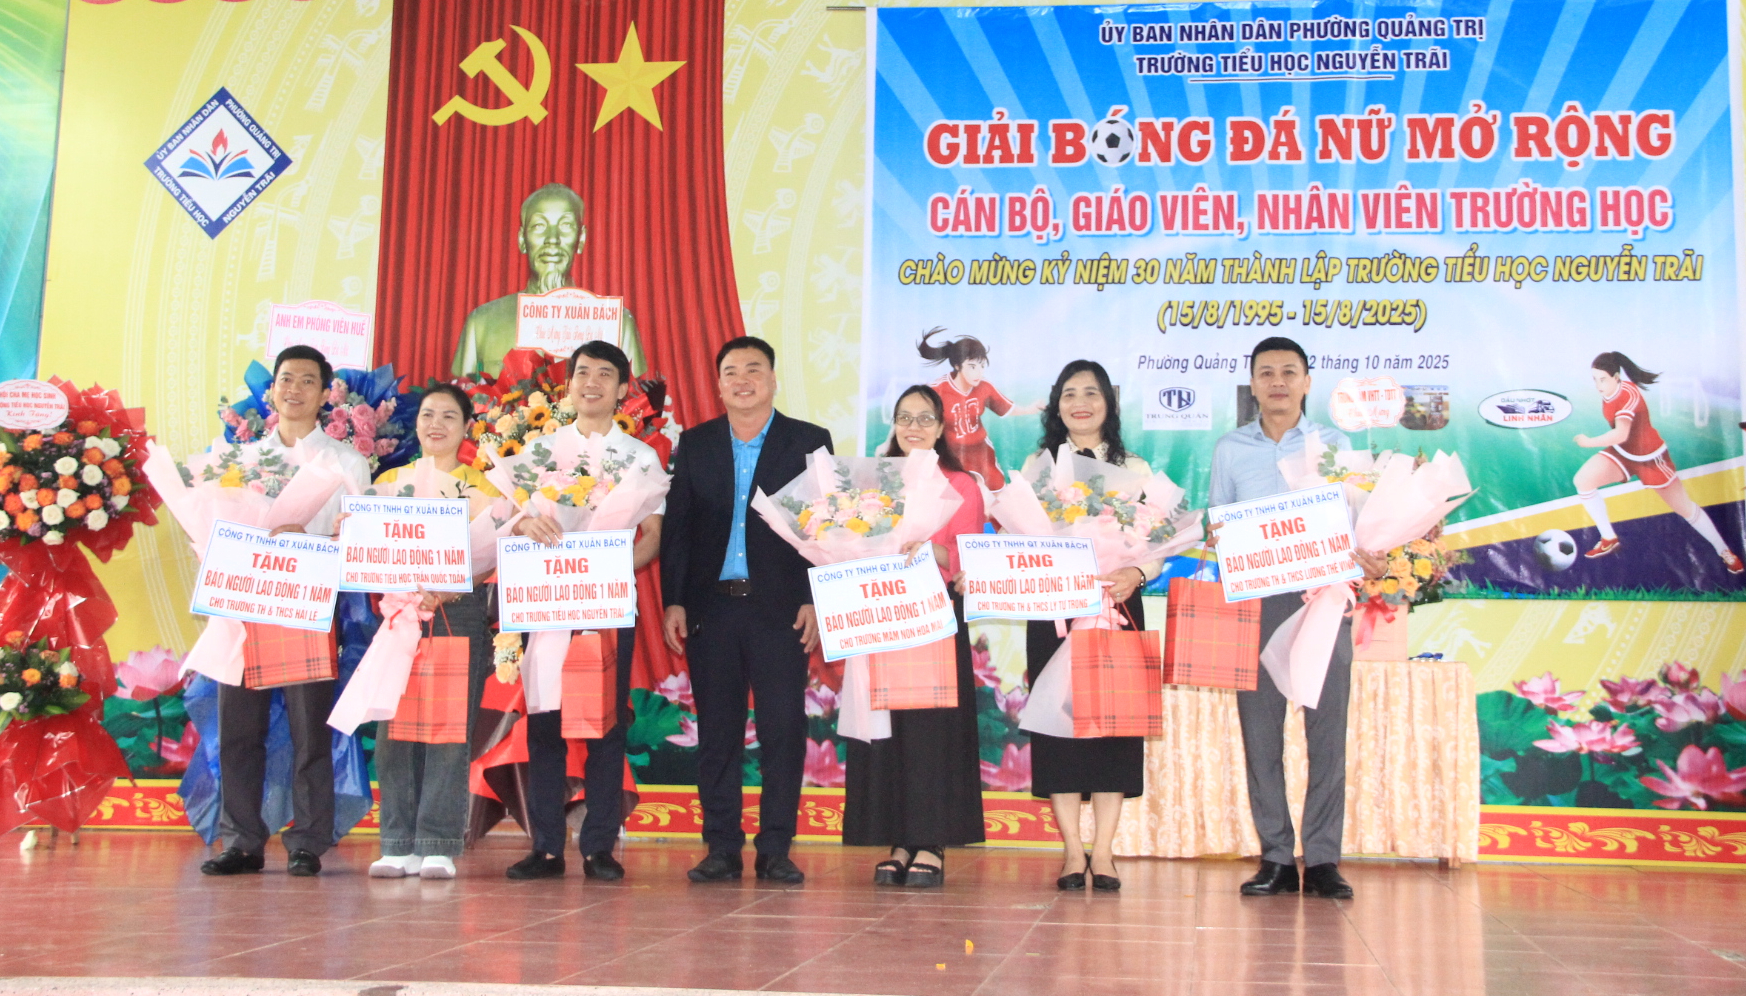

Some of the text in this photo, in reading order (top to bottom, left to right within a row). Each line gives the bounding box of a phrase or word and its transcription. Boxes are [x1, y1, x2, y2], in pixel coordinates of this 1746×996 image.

[1101, 14, 1484, 43] ỦY BAN NHÂN DÂN PHƯỜNG QUẢNG TRỊ
[1136, 46, 1448, 76] TRƯỜNG TIỂU HỌC NGUYỄN TRÃI
[157, 99, 219, 160] ỦY BAN NHÂN DÂN
[225, 99, 281, 159] PHƯỜNG QUẢNG TRỊ
[927, 111, 1034, 164] GIẢI
[1229, 109, 1302, 162] ĐÁ
[1319, 108, 1392, 161] NỮ
[1406, 104, 1496, 159] MỞ
[1513, 104, 1672, 168] RỘNG
[154, 166, 209, 226] TRƯỜNG TIỂU HỌC
[222, 172, 276, 223] NGUYỄN TRÃI
[930, 182, 1669, 240] CÁN BỘ, GIÁO VIÊN, NHÂN VIÊN TRƯỜNG HỌC
[899, 243, 1704, 291] CHÀO MỪNG KỶ NIỆM 30 NĂM THÀNH LẬP TRƯỜNG TIỂU HỌC NGUYỄN TRÃI
[275, 313, 291, 328] ANH
[293, 316, 304, 329] EM
[333, 317, 349, 334] VIÊN
[523, 302, 617, 320] CÔNG TY XUÂN BÁCH
[1157, 300, 1284, 333] (15/8/1995
[1302, 300, 1427, 333] 15/8/2025)
[1138, 355, 1188, 373] Phường
[1194, 352, 1237, 373] Quảng
[1321, 355, 1359, 373] tháng
[1364, 355, 1378, 369] 10
[1383, 355, 1413, 369] năm
[1418, 355, 1449, 369] 2025
[951, 398, 979, 438] 10
[349, 501, 462, 515] CÔNG TY TNHH QT XUÂN BÁCH
[1218, 491, 1339, 522] CÔNG TY TNHH QT XUÂN BÁCH
[218, 527, 339, 553] CÔNG TY TNHH QT XUÂN BÁCH
[384, 519, 425, 542] TẶNG
[1259, 517, 1306, 541] TẶNG
[346, 543, 465, 569] BÁO NGƯỜI LAO ĐỘNG 1 NĂM
[505, 542, 530, 552] CÔNG
[566, 541, 576, 549] QT
[579, 537, 601, 548] XUÂN
[604, 536, 626, 547] BÁCH
[965, 539, 990, 548] CÔNG
[1041, 540, 1062, 548] XUÂN
[1065, 539, 1088, 549] BÁCH
[1226, 532, 1350, 573] BÁO NGƯỜI LAO ĐỘNG 1 NĂM
[252, 551, 297, 573] TẶNG
[544, 555, 589, 578] TẶNG
[1006, 552, 1053, 572] TẶNG
[204, 567, 332, 603] BÁO NGƯỜI LAO ĐỘNG 1 NĂM
[506, 578, 628, 604] BÁO NGƯỜI LAO ĐỘNG 1 NĂM
[860, 579, 907, 601] TẶNG
[969, 572, 1095, 596] BÁO NGƯỜI LAO ĐỘNG 1 NĂM
[825, 591, 947, 632] BÁO NGƯỜI LAO ĐỘNG 1 NĂM
